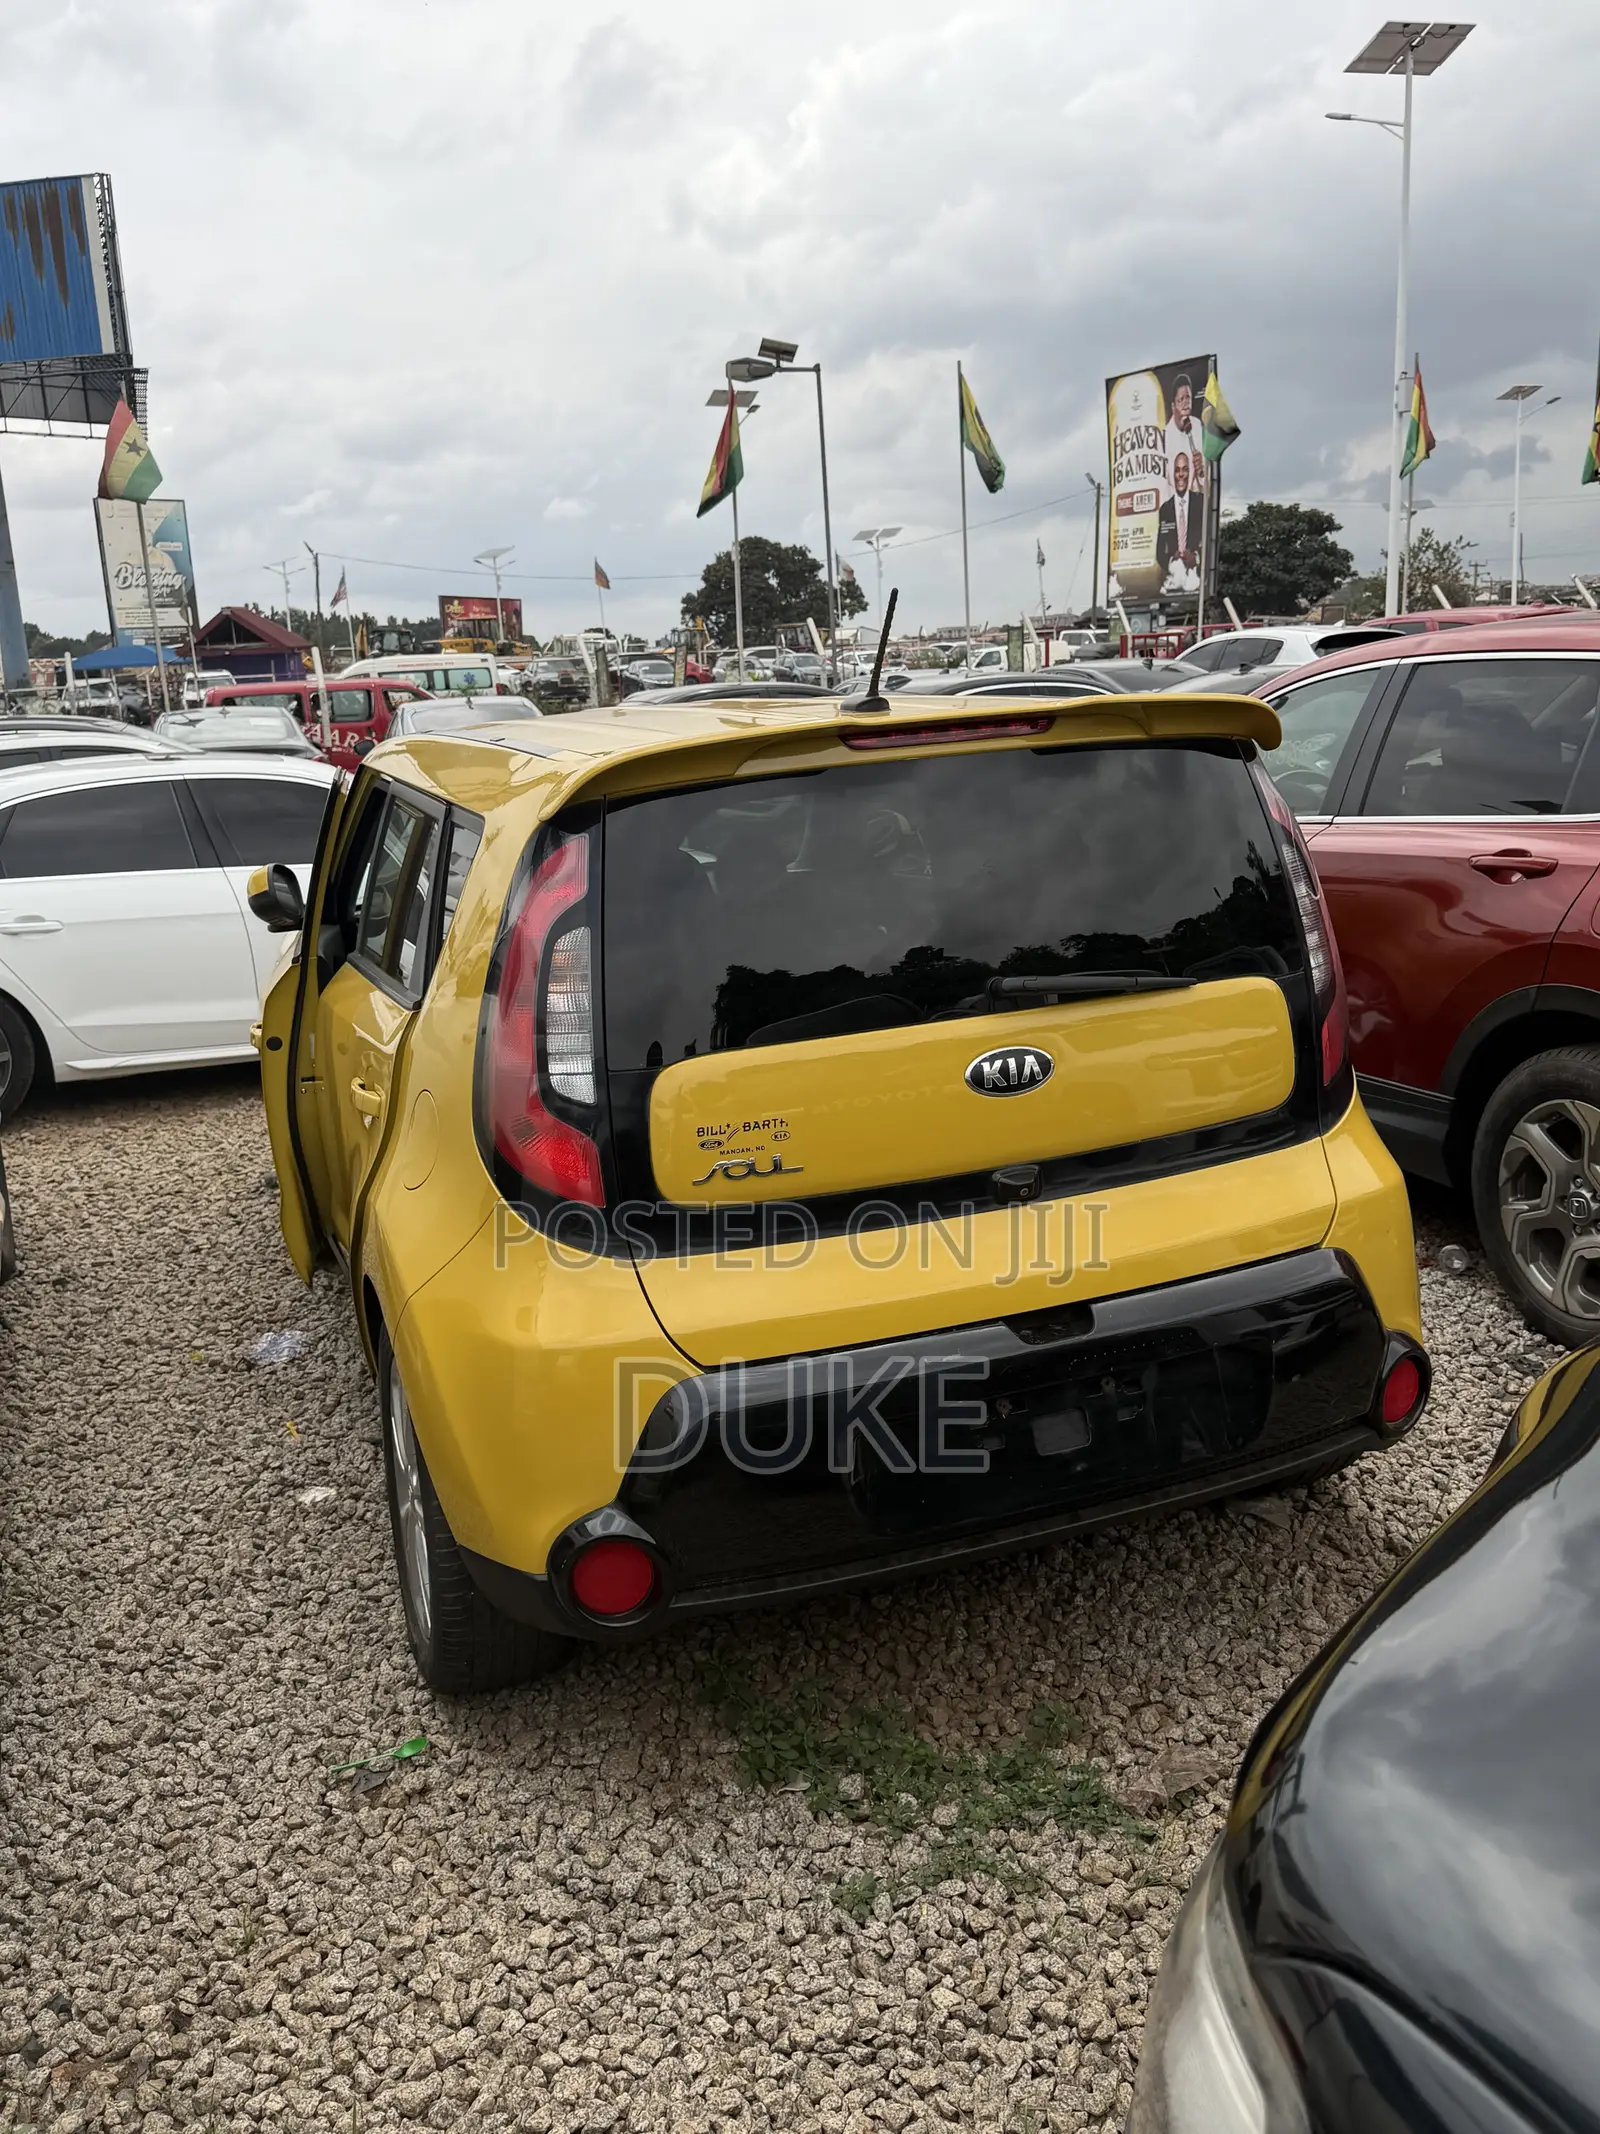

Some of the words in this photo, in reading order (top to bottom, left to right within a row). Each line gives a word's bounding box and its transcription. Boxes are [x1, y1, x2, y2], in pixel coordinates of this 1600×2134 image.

[1113, 425, 1166, 465] HEAVEN
[1113, 461, 1123, 488] IS
[1125, 456, 1134, 478] A
[1135, 453, 1169, 479] MUST
[979, 1053, 1045, 1090] KIA
[696, 1125, 726, 1137] BILL
[773, 1132, 789, 1140] KIA
